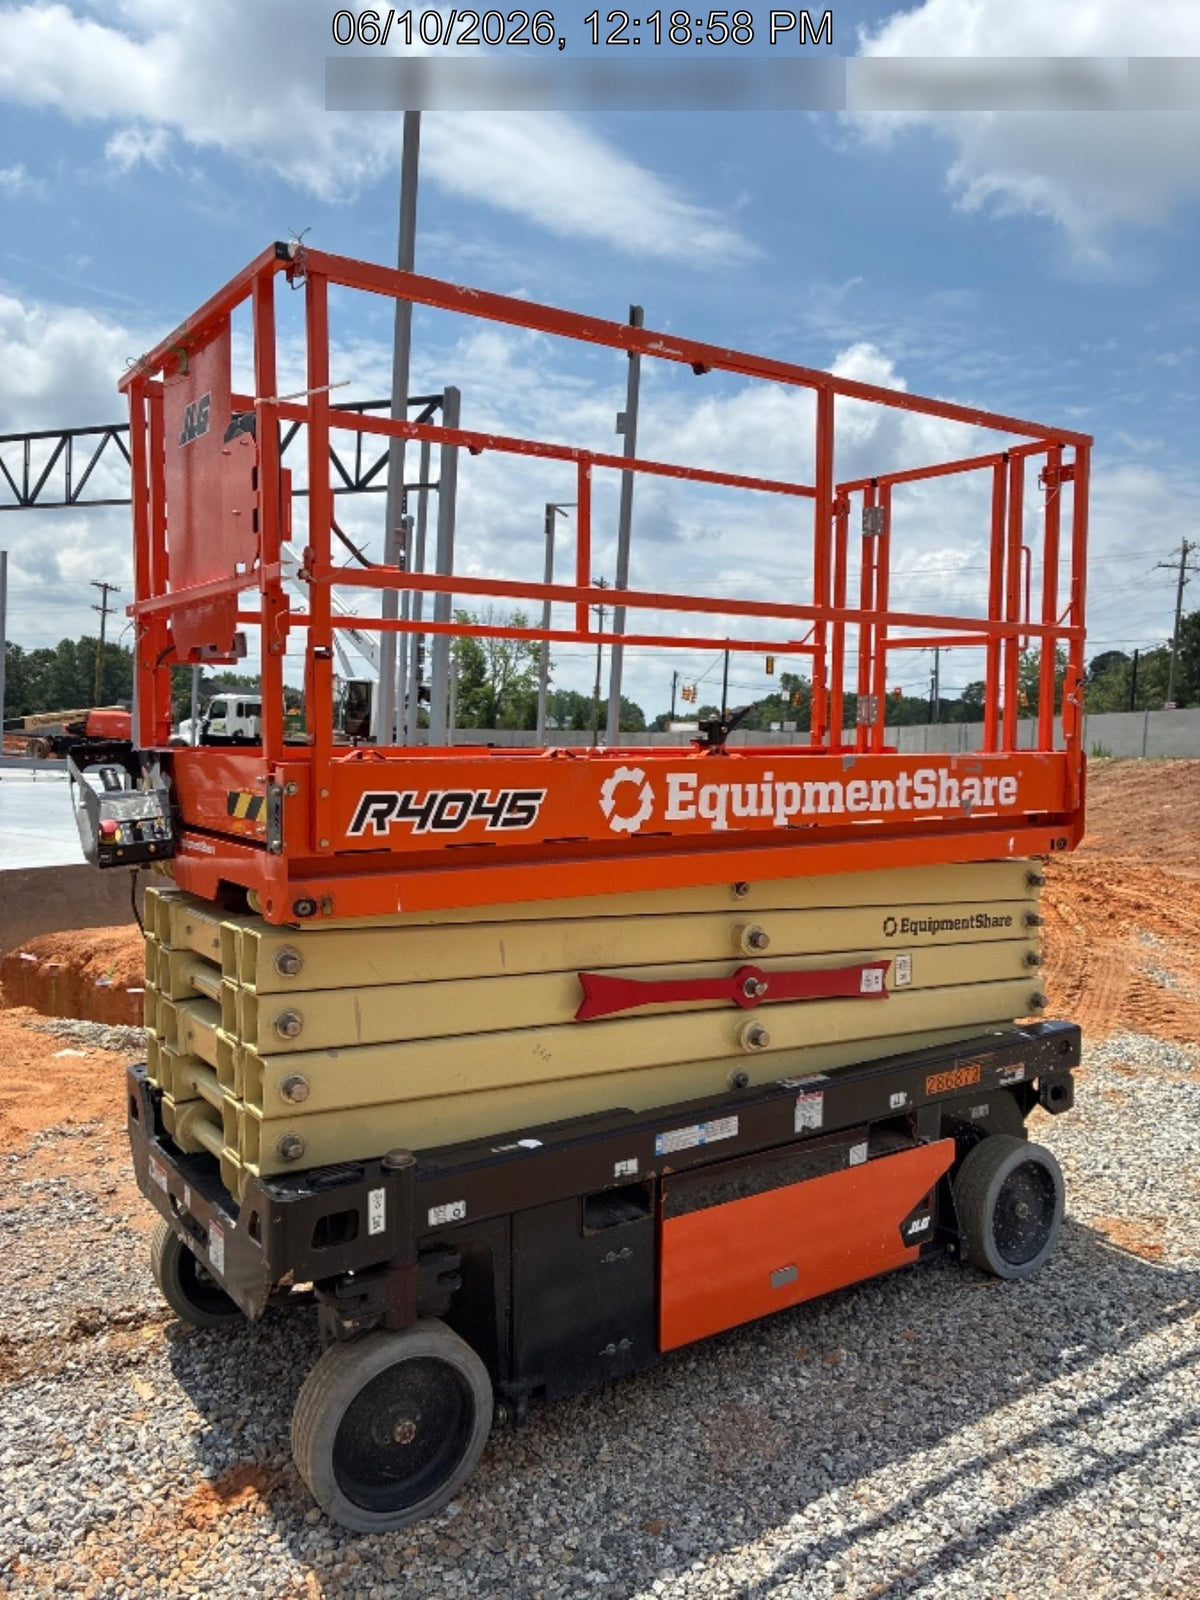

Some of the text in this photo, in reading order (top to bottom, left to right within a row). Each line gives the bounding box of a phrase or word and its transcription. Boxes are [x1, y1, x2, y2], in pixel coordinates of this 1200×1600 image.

[346, 788, 548, 836] R4045
[665, 769, 1018, 831] EquipmentShare
[899, 913, 1013, 936] EquipmentShare
